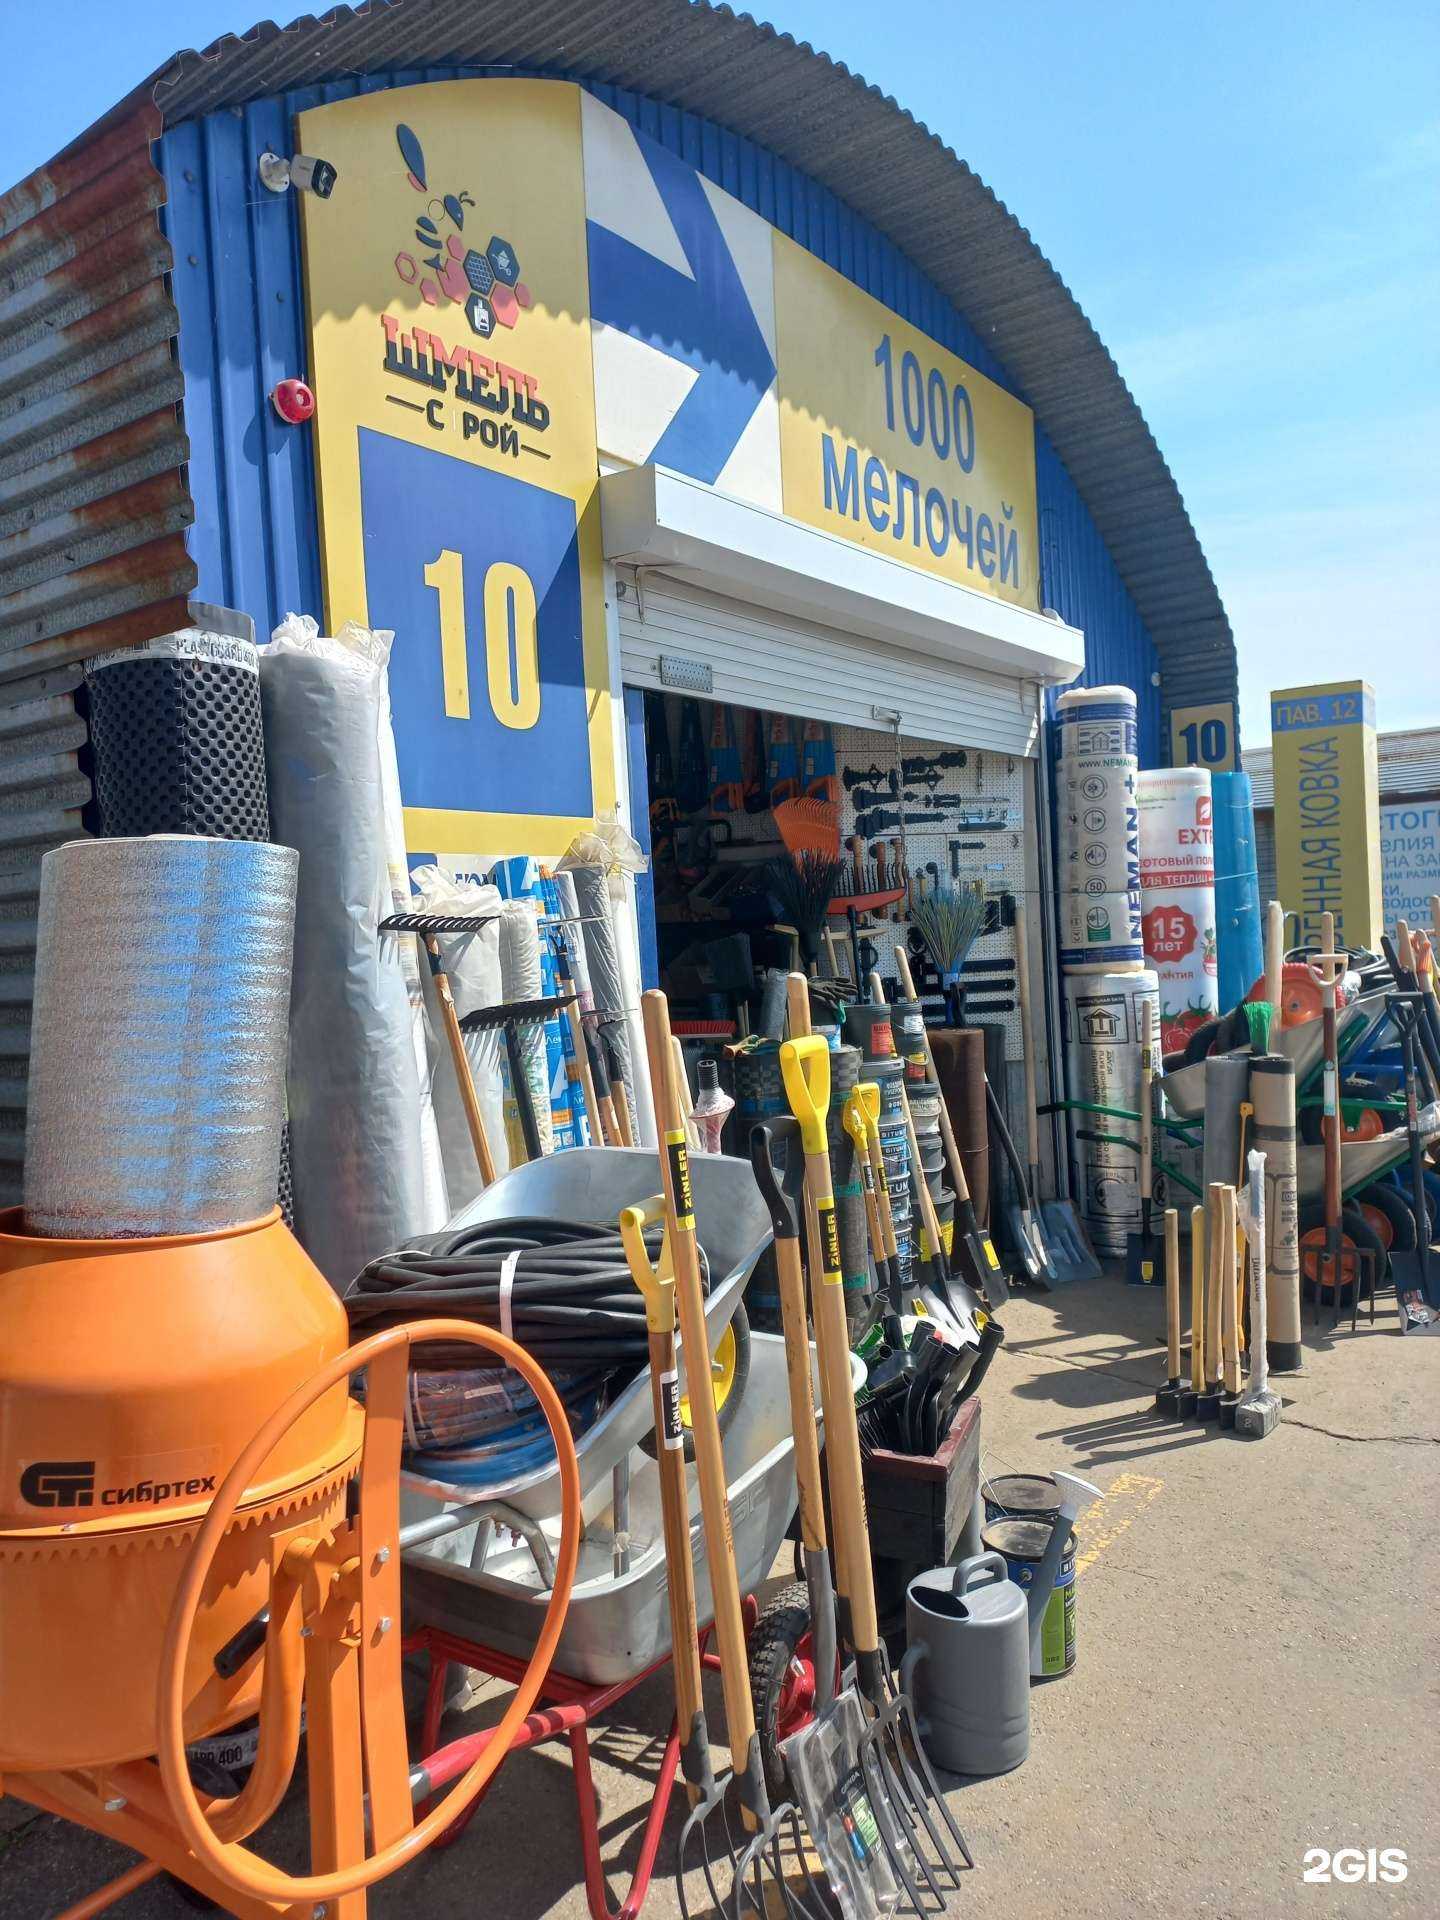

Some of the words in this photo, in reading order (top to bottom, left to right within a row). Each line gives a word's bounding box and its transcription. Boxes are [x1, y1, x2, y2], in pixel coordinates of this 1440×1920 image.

[381, 314, 550, 433] ШМЕЛЬ
[874, 334, 976, 475] 1000
[424, 548, 542, 730] 10
[1331, 699, 1356, 720] 12
[1179, 719, 1226, 764] 10
[1298, 735, 1341, 829] КОВКА
[1153, 917, 1186, 940] 15
[1153, 939, 1185, 953] лет
[101, 1475, 217, 1506] сибртех
